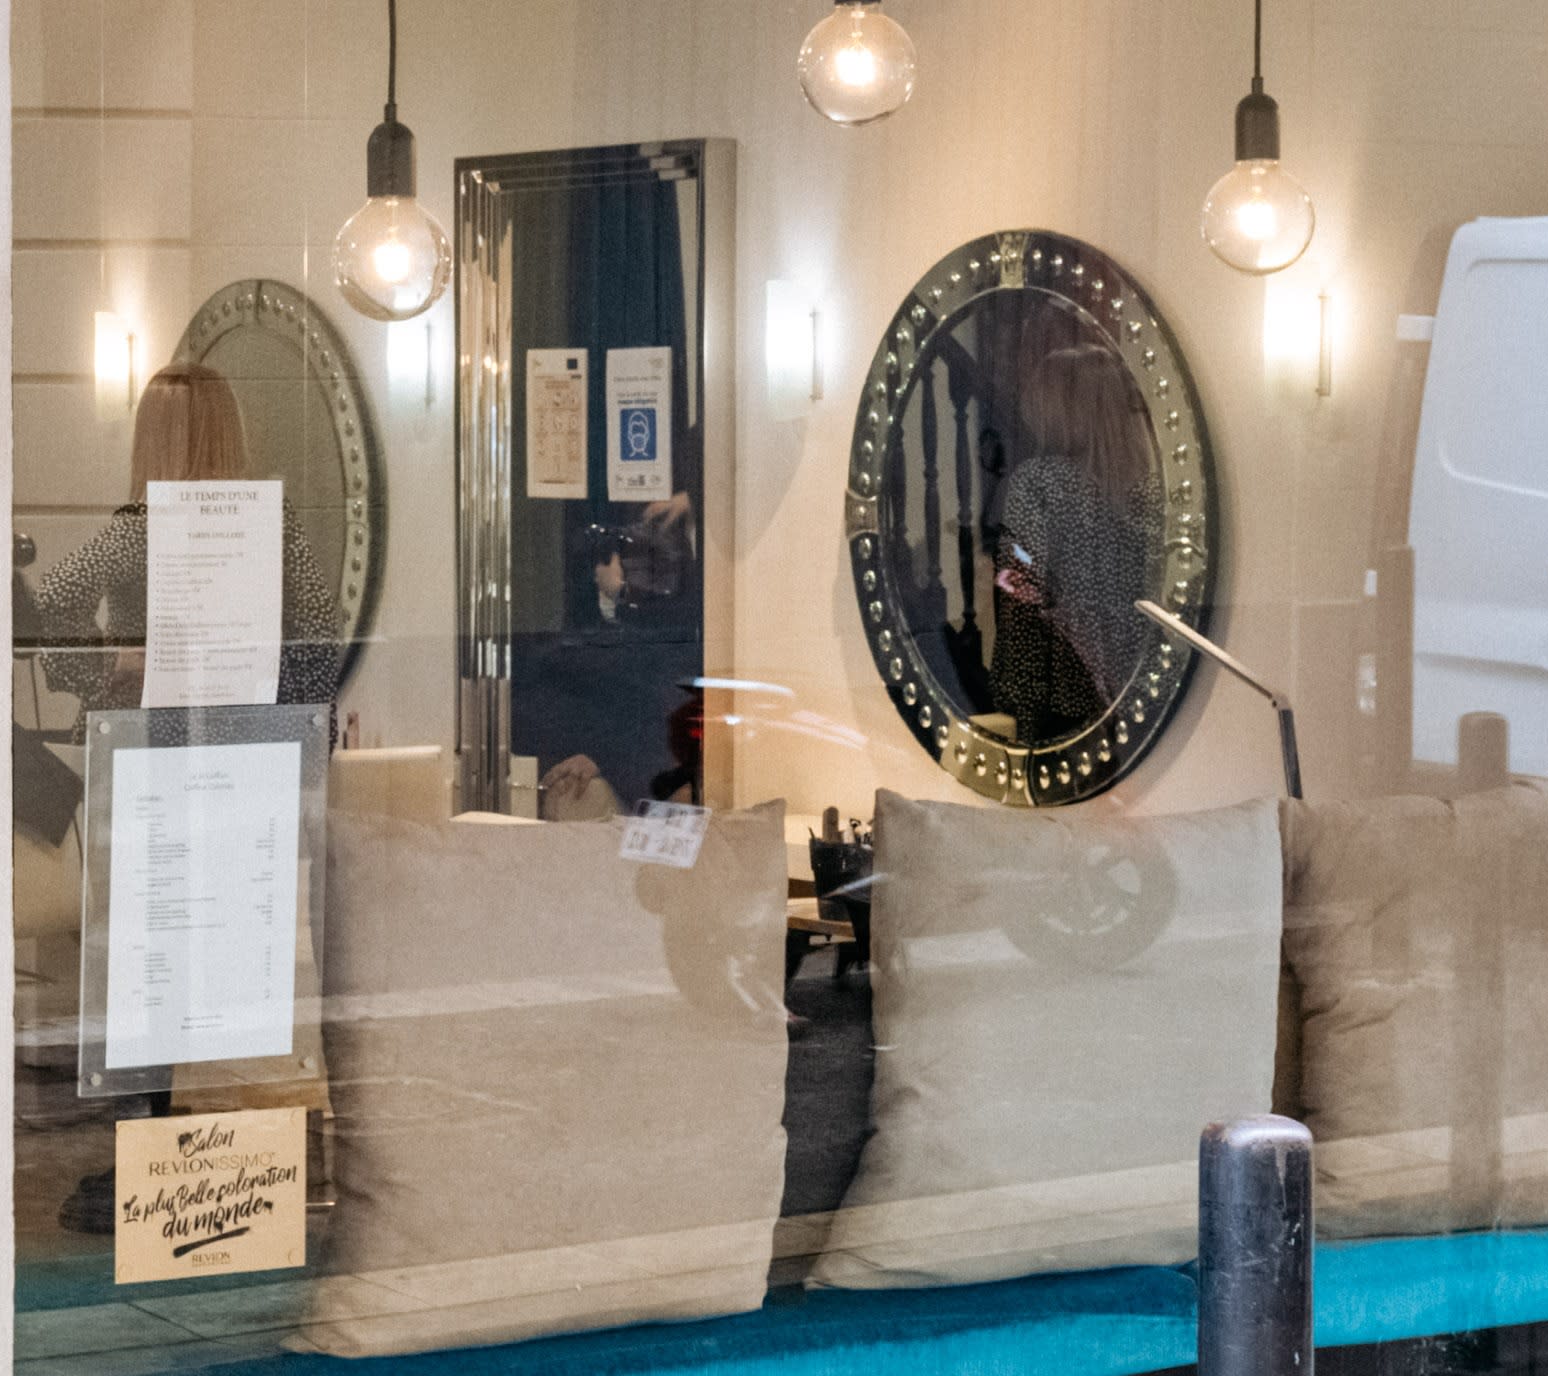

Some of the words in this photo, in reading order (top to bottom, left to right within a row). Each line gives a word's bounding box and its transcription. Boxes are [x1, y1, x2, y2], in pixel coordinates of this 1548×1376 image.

[182, 1122, 235, 1158] Salon
[149, 1152, 273, 1177] REVLONISSIMO
[123, 1194, 140, 1224] La
[144, 1188, 176, 1222] plus
[178, 1177, 215, 1210] Belle
[217, 1166, 297, 1203] coloration
[162, 1212, 190, 1239] du
[195, 1192, 265, 1230] monde
